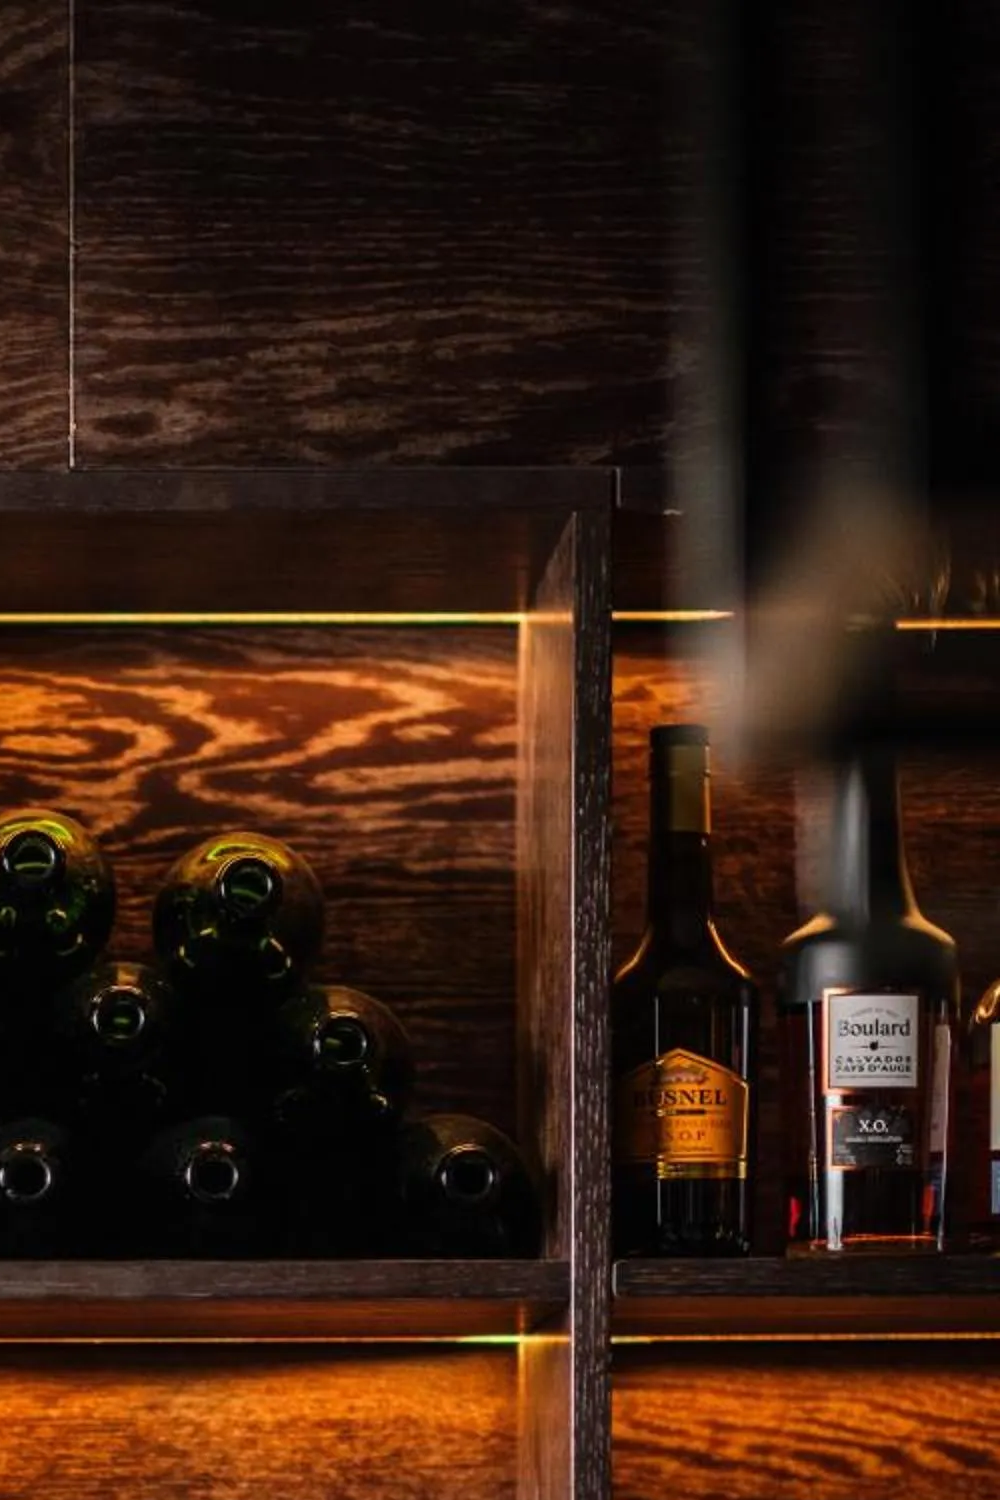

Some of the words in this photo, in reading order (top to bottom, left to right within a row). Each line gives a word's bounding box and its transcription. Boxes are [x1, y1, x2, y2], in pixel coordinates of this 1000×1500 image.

[838, 1017, 911, 1037] Boulard
[835, 1055, 911, 1063] CALVADOS
[835, 1064, 864, 1073] PAYS
[867, 1063, 911, 1073] D'AUGE
